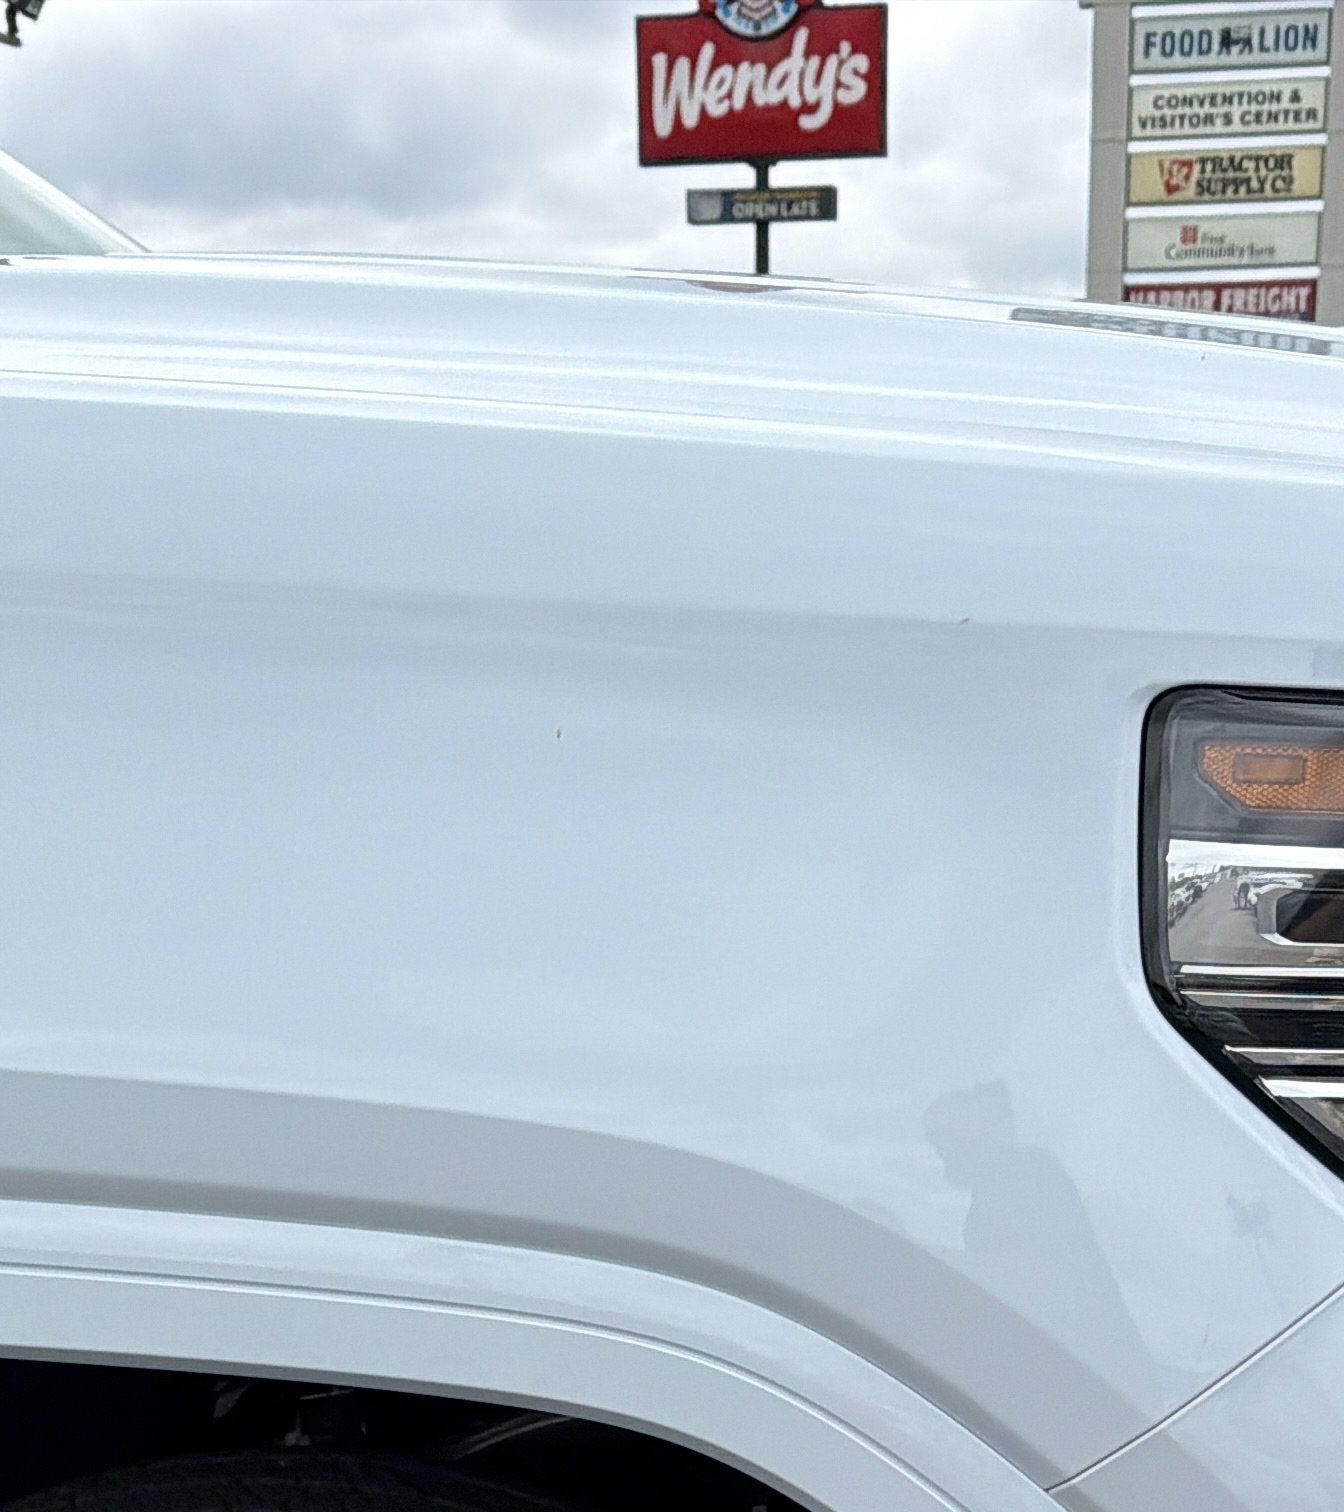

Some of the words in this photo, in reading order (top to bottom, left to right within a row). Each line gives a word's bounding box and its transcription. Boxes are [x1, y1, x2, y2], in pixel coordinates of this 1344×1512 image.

[1143, 29, 1213, 58] FOOD
[1259, 23, 1319, 53] LION
[651, 26, 870, 139] Wendy's
[1152, 89, 1283, 110] CONVENTION
[1288, 88, 1302, 104] &
[1137, 111, 1233, 130] VISITOR'S
[1239, 108, 1318, 126] CENTER
[1195, 153, 1294, 175] TRACTOR
[1195, 176, 1267, 196] SUPPLY
[1220, 284, 1312, 314] FREIGHT
